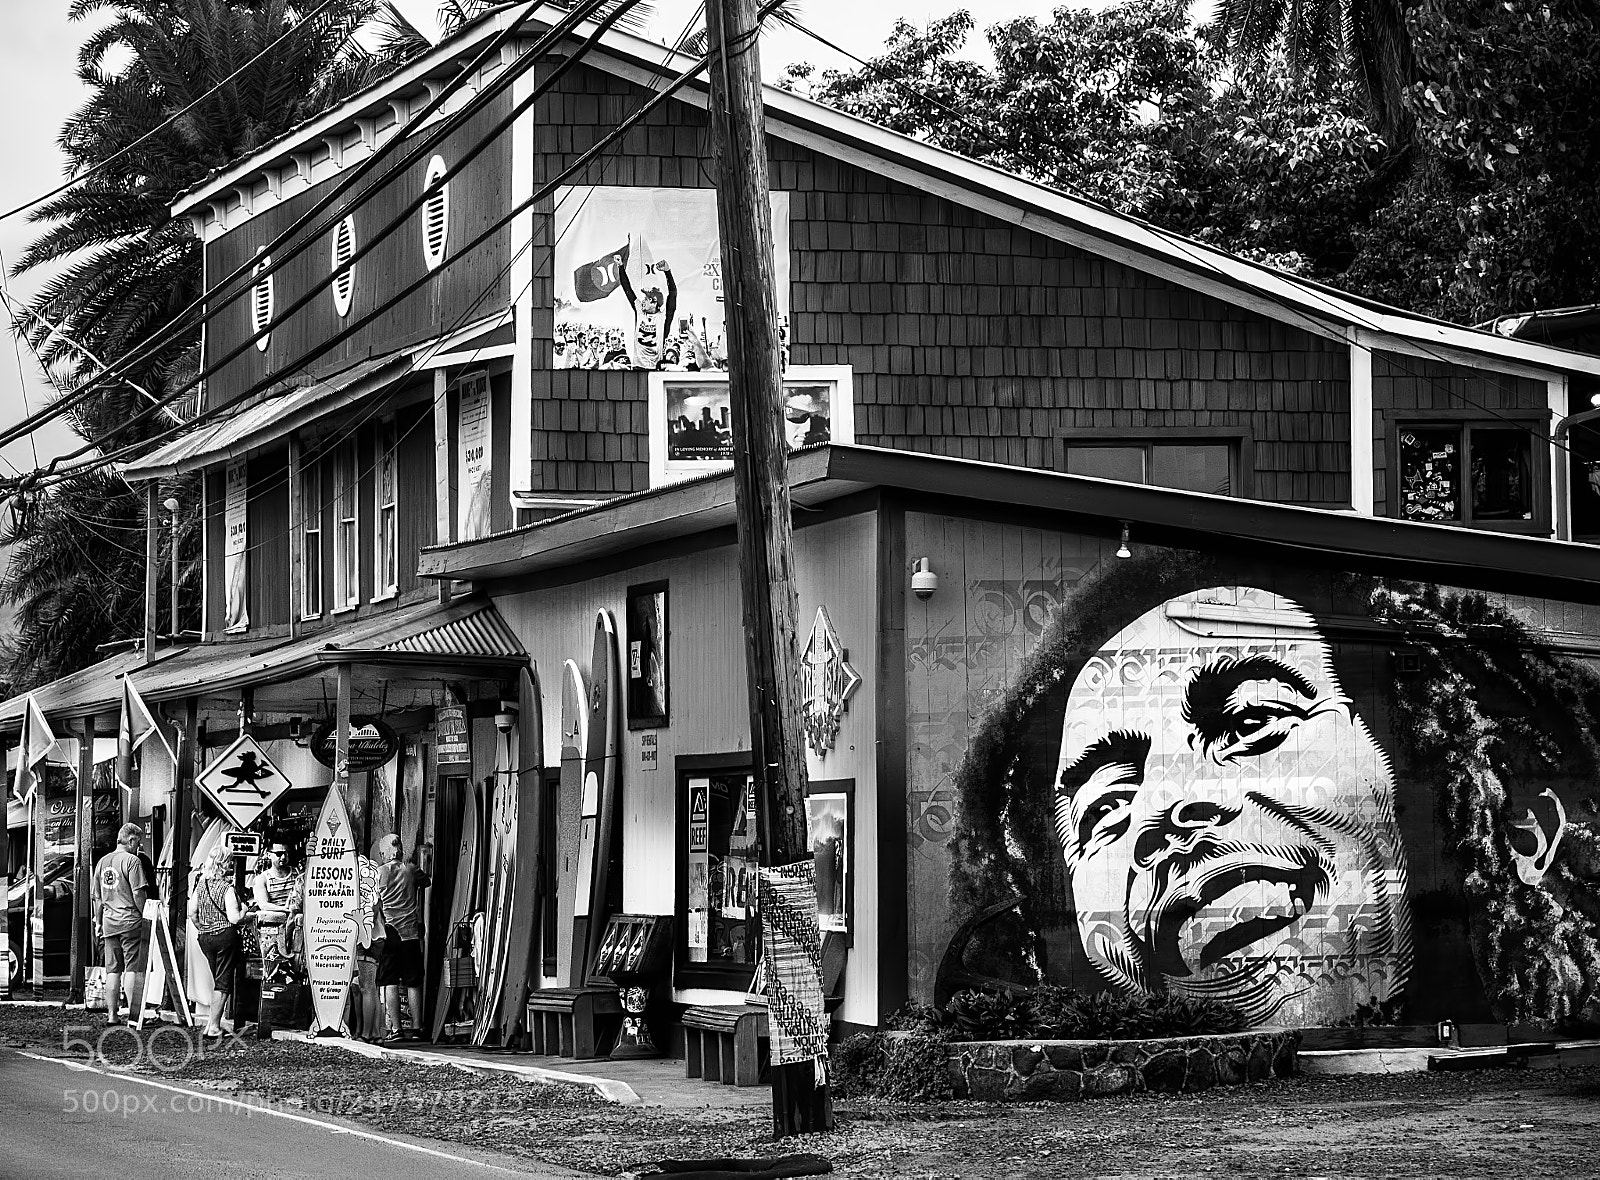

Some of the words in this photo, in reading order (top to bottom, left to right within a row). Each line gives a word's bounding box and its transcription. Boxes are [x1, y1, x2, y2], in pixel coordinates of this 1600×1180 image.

[691, 827, 706, 846] REEF
[321, 838, 346, 847] DAILY
[320, 847, 345, 860] SURF
[311, 866, 353, 880] LESSONS
[308, 889, 326, 897] SURF
[328, 889, 354, 897] SAFARI
[319, 900, 344, 908] TOURS
[316, 917, 346, 925] Beginner
[310, 926, 352, 934] Intermediate
